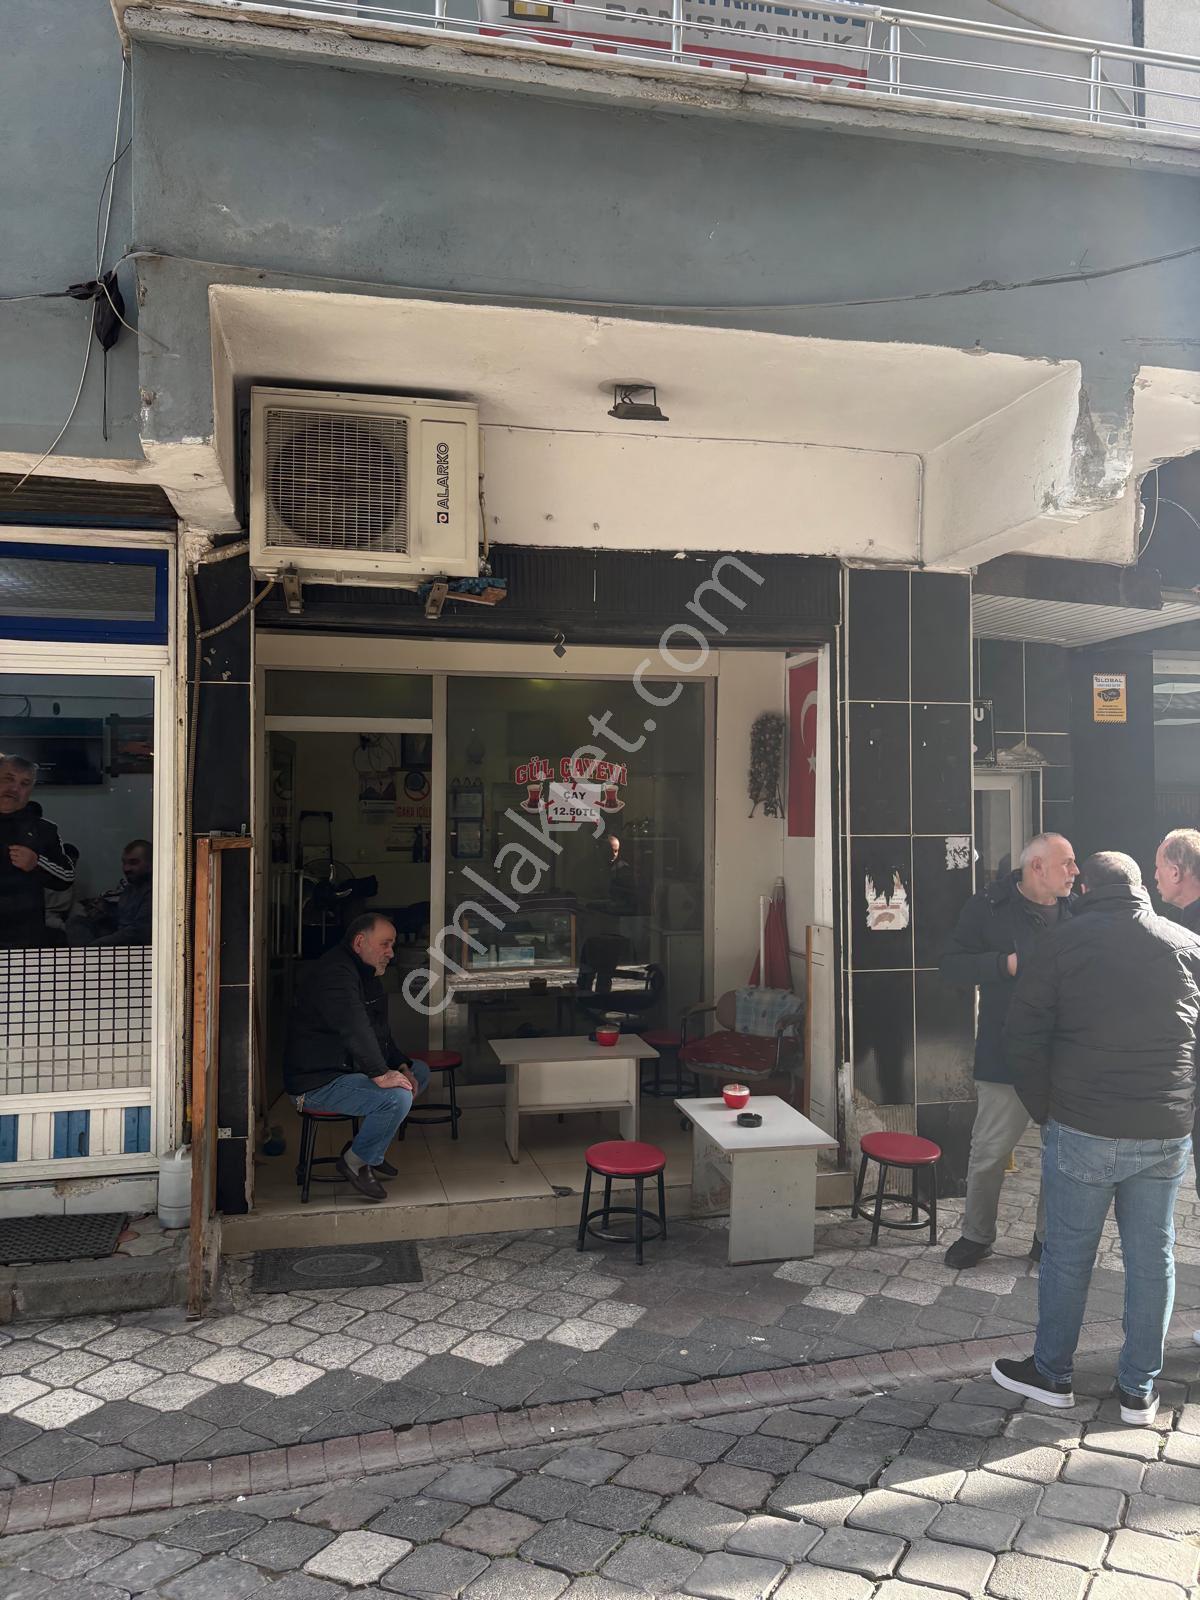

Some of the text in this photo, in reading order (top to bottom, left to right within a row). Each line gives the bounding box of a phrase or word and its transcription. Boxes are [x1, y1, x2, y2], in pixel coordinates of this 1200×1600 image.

[437, 443, 449, 509] ALARKO
[515, 756, 628, 786] GÜL ÇAYEVİ
[563, 791, 587, 802] ÇAY
[553, 807, 596, 817] 12.50TL
